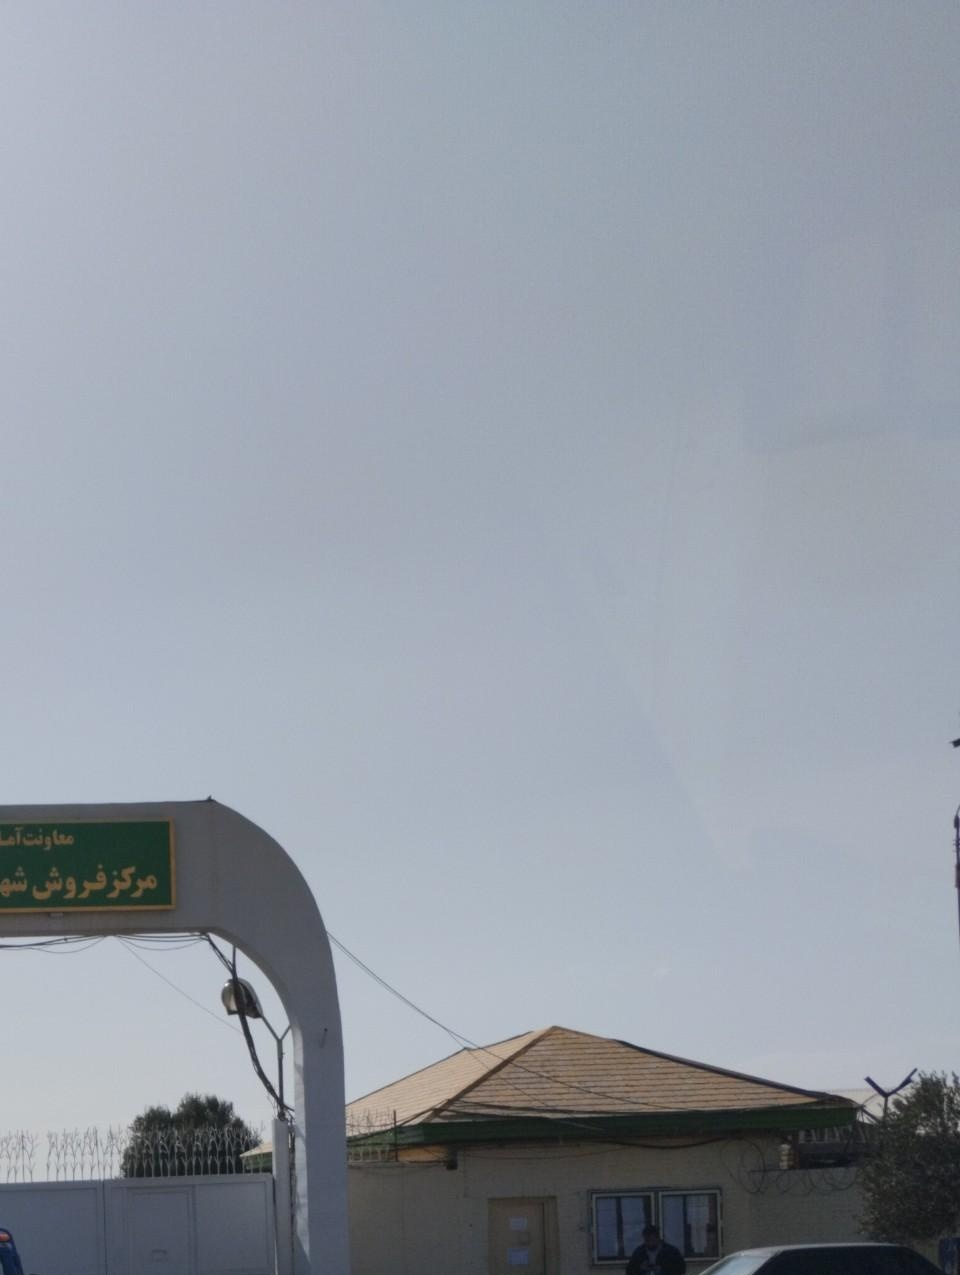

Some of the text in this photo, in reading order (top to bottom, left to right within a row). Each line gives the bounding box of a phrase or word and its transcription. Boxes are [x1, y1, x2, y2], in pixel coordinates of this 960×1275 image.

[23, 829, 74, 851] معاونت
[32, 863, 108, 901] فروش
[107, 866, 157, 898] مرکز
